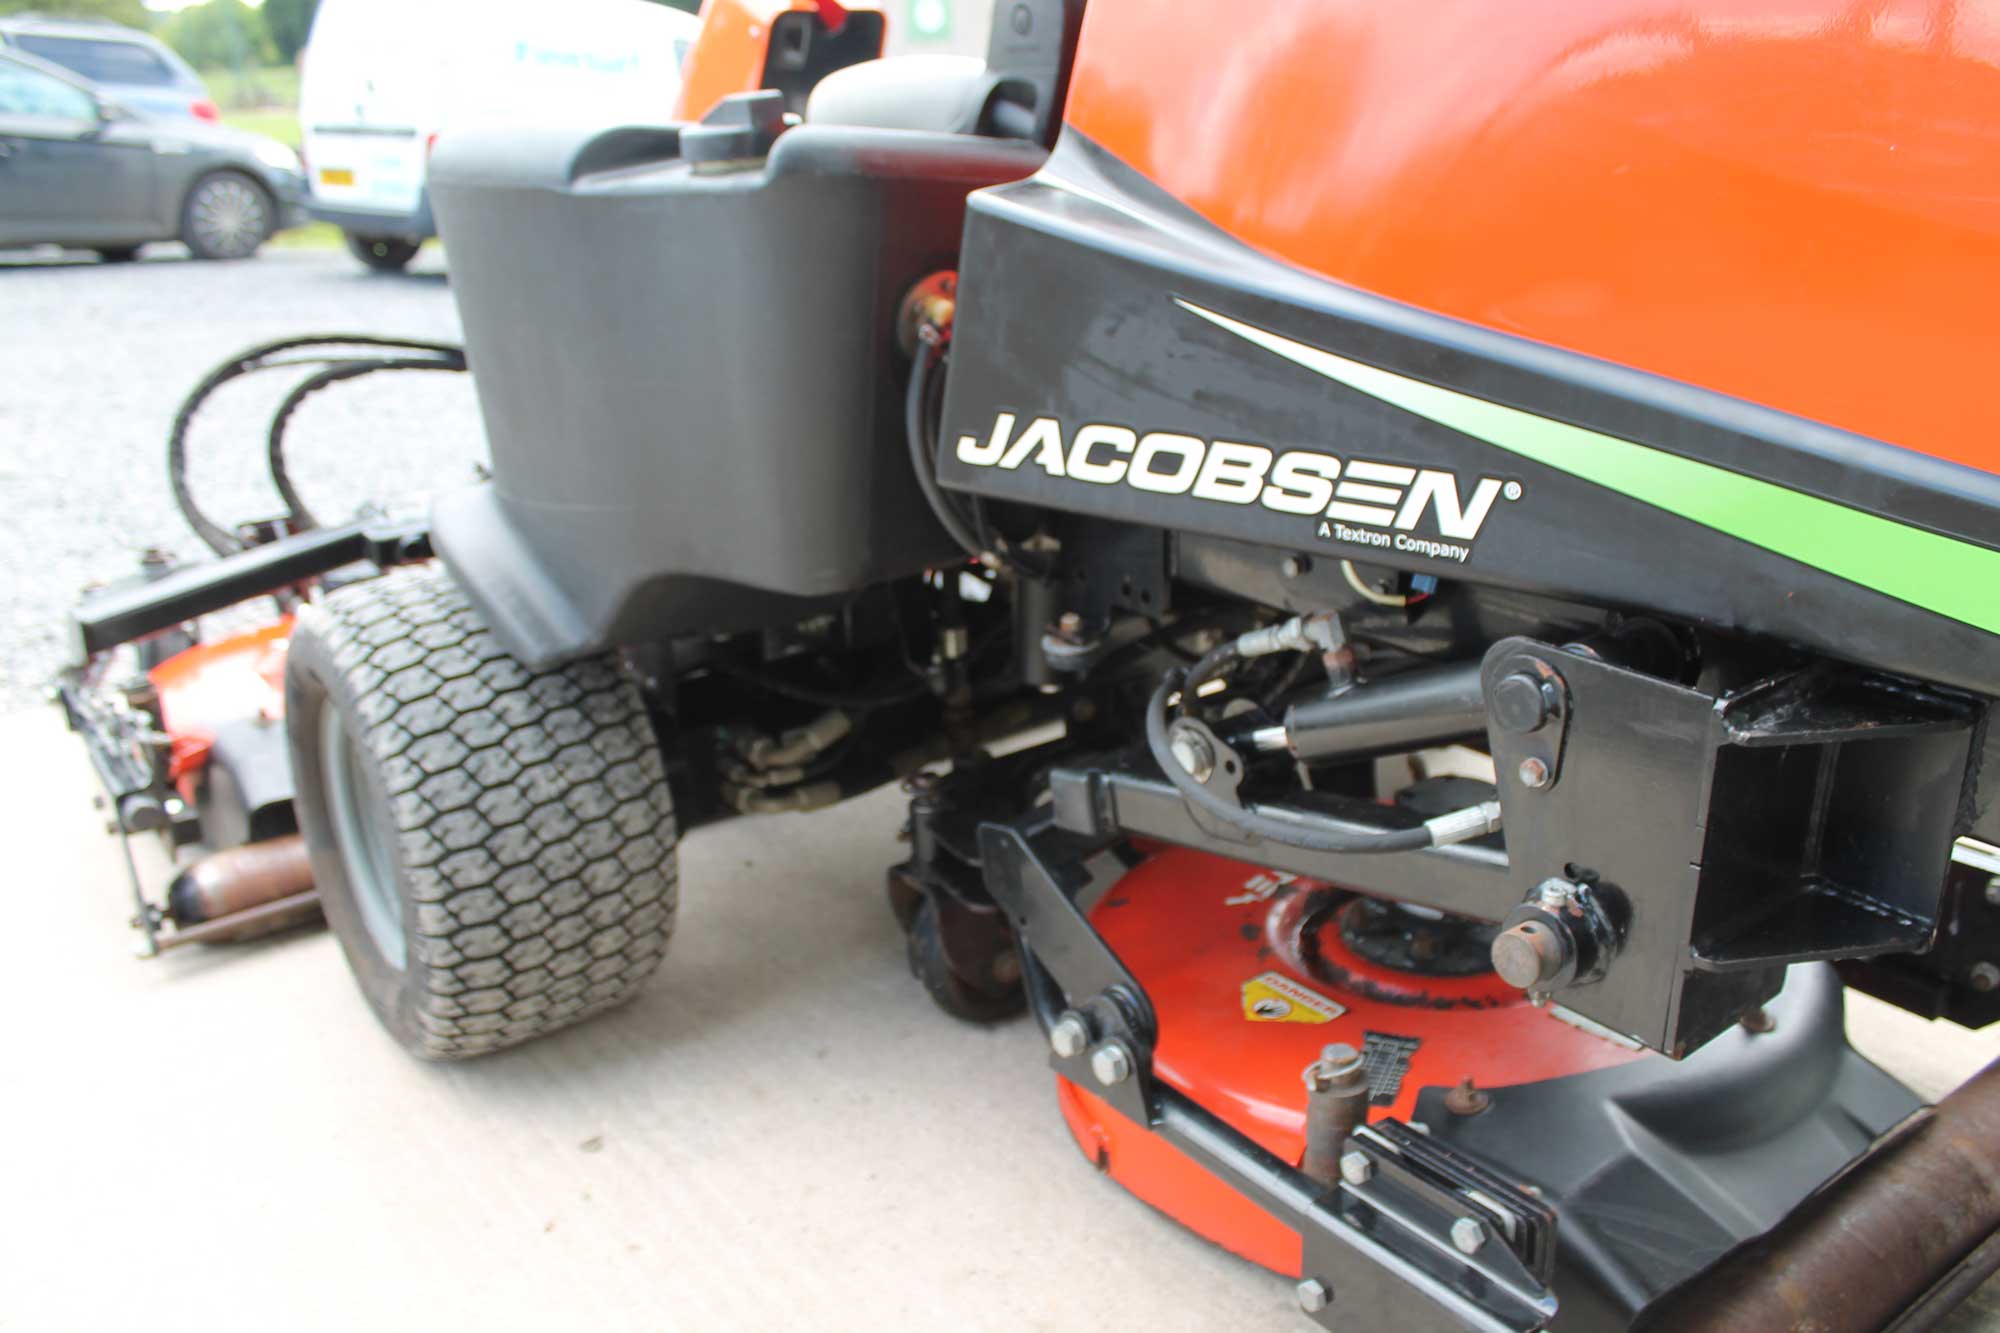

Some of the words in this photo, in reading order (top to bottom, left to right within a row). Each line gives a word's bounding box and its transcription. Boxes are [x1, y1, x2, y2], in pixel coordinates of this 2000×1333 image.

[956, 412, 1503, 541] JACOBSEN
[1318, 520, 1332, 538] A
[1334, 523, 1392, 548] Textron
[1394, 533, 1470, 563] Company
[1263, 975, 1338, 1014] DANGER
